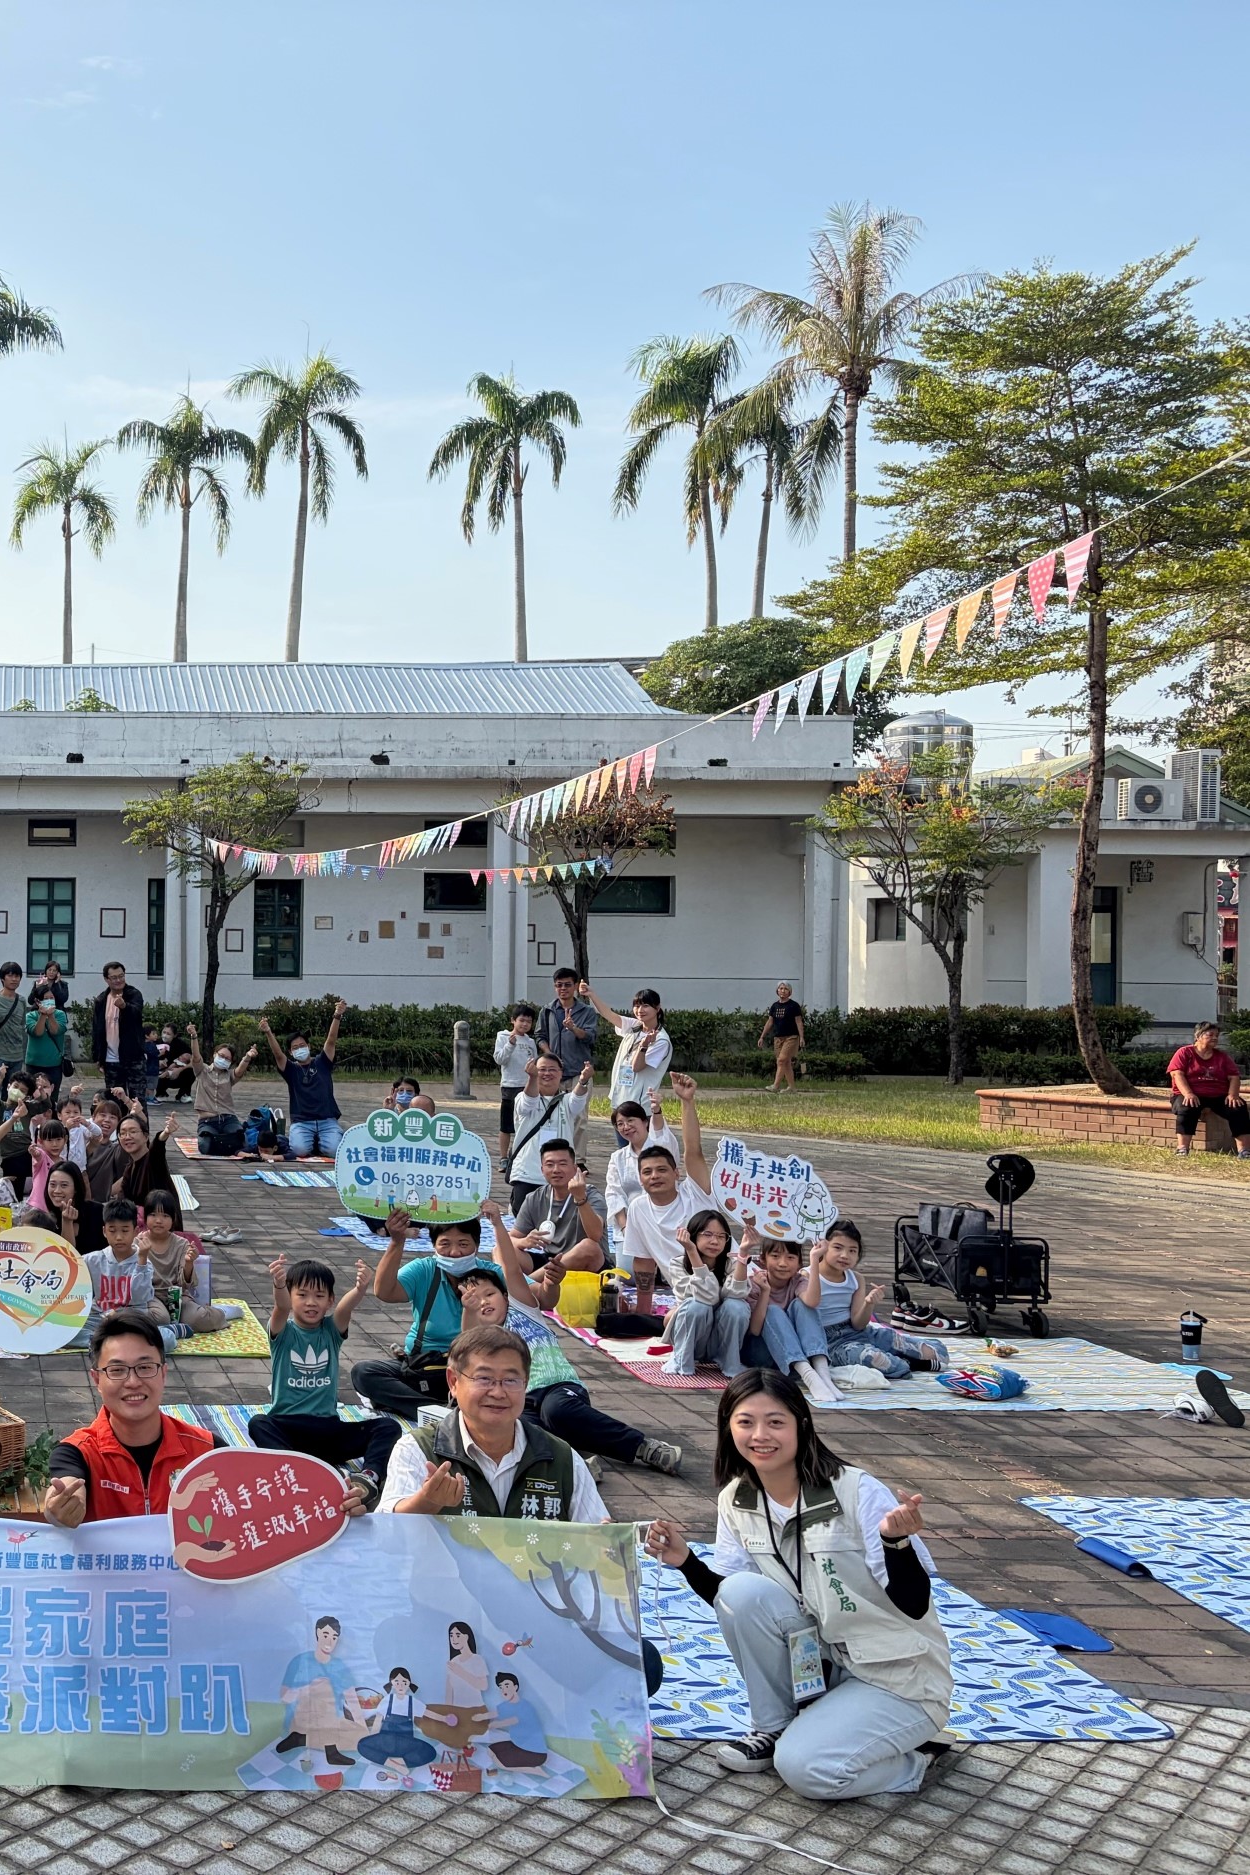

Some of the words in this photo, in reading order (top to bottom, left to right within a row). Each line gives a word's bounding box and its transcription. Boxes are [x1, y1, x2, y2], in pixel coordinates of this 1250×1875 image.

[373, 1116, 455, 1141] 新豐區
[345, 1146, 482, 1173] 社會福利服務中心
[722, 1140, 811, 1183] 攜手共創
[381, 1171, 472, 1190] 06-3387851
[719, 1168, 788, 1209] 好時光
[287, 1375, 332, 1388] adidas
[211, 1463, 308, 1518] 攜手守護
[821, 1557, 858, 1613] 社會局
